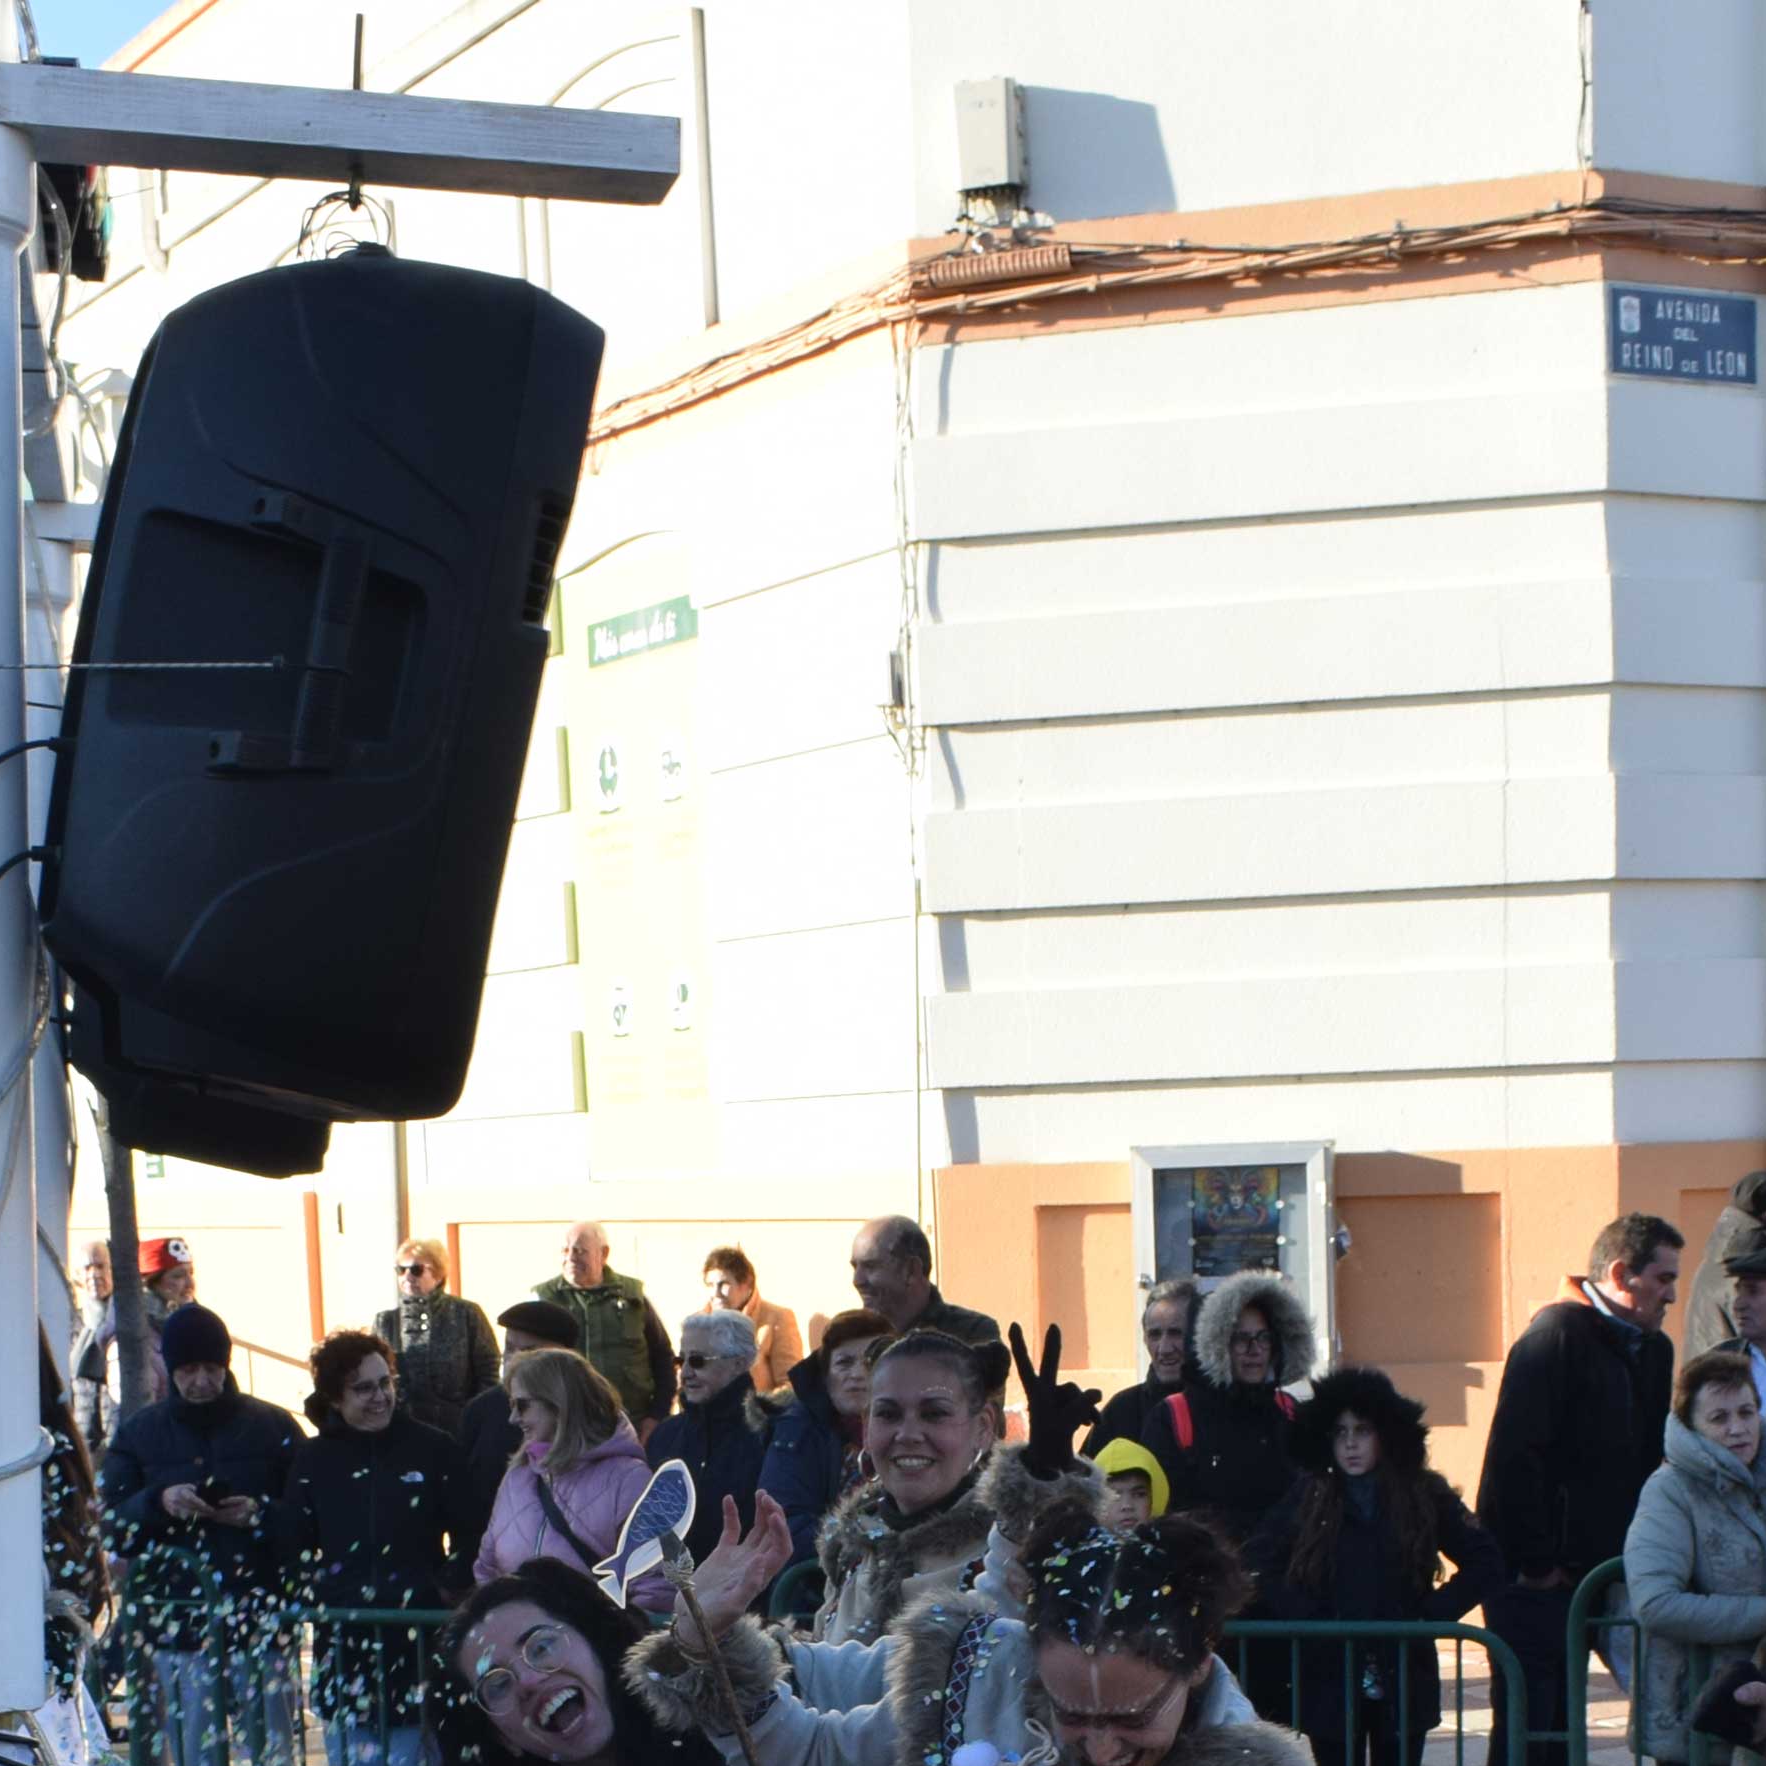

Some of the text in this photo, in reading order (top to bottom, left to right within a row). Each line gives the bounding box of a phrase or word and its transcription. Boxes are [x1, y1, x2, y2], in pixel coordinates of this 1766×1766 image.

[1655, 299, 1721, 324] AVENIDA
[1673, 327, 1699, 342] DEL
[1622, 342, 1747, 377] REINO DE LEON
